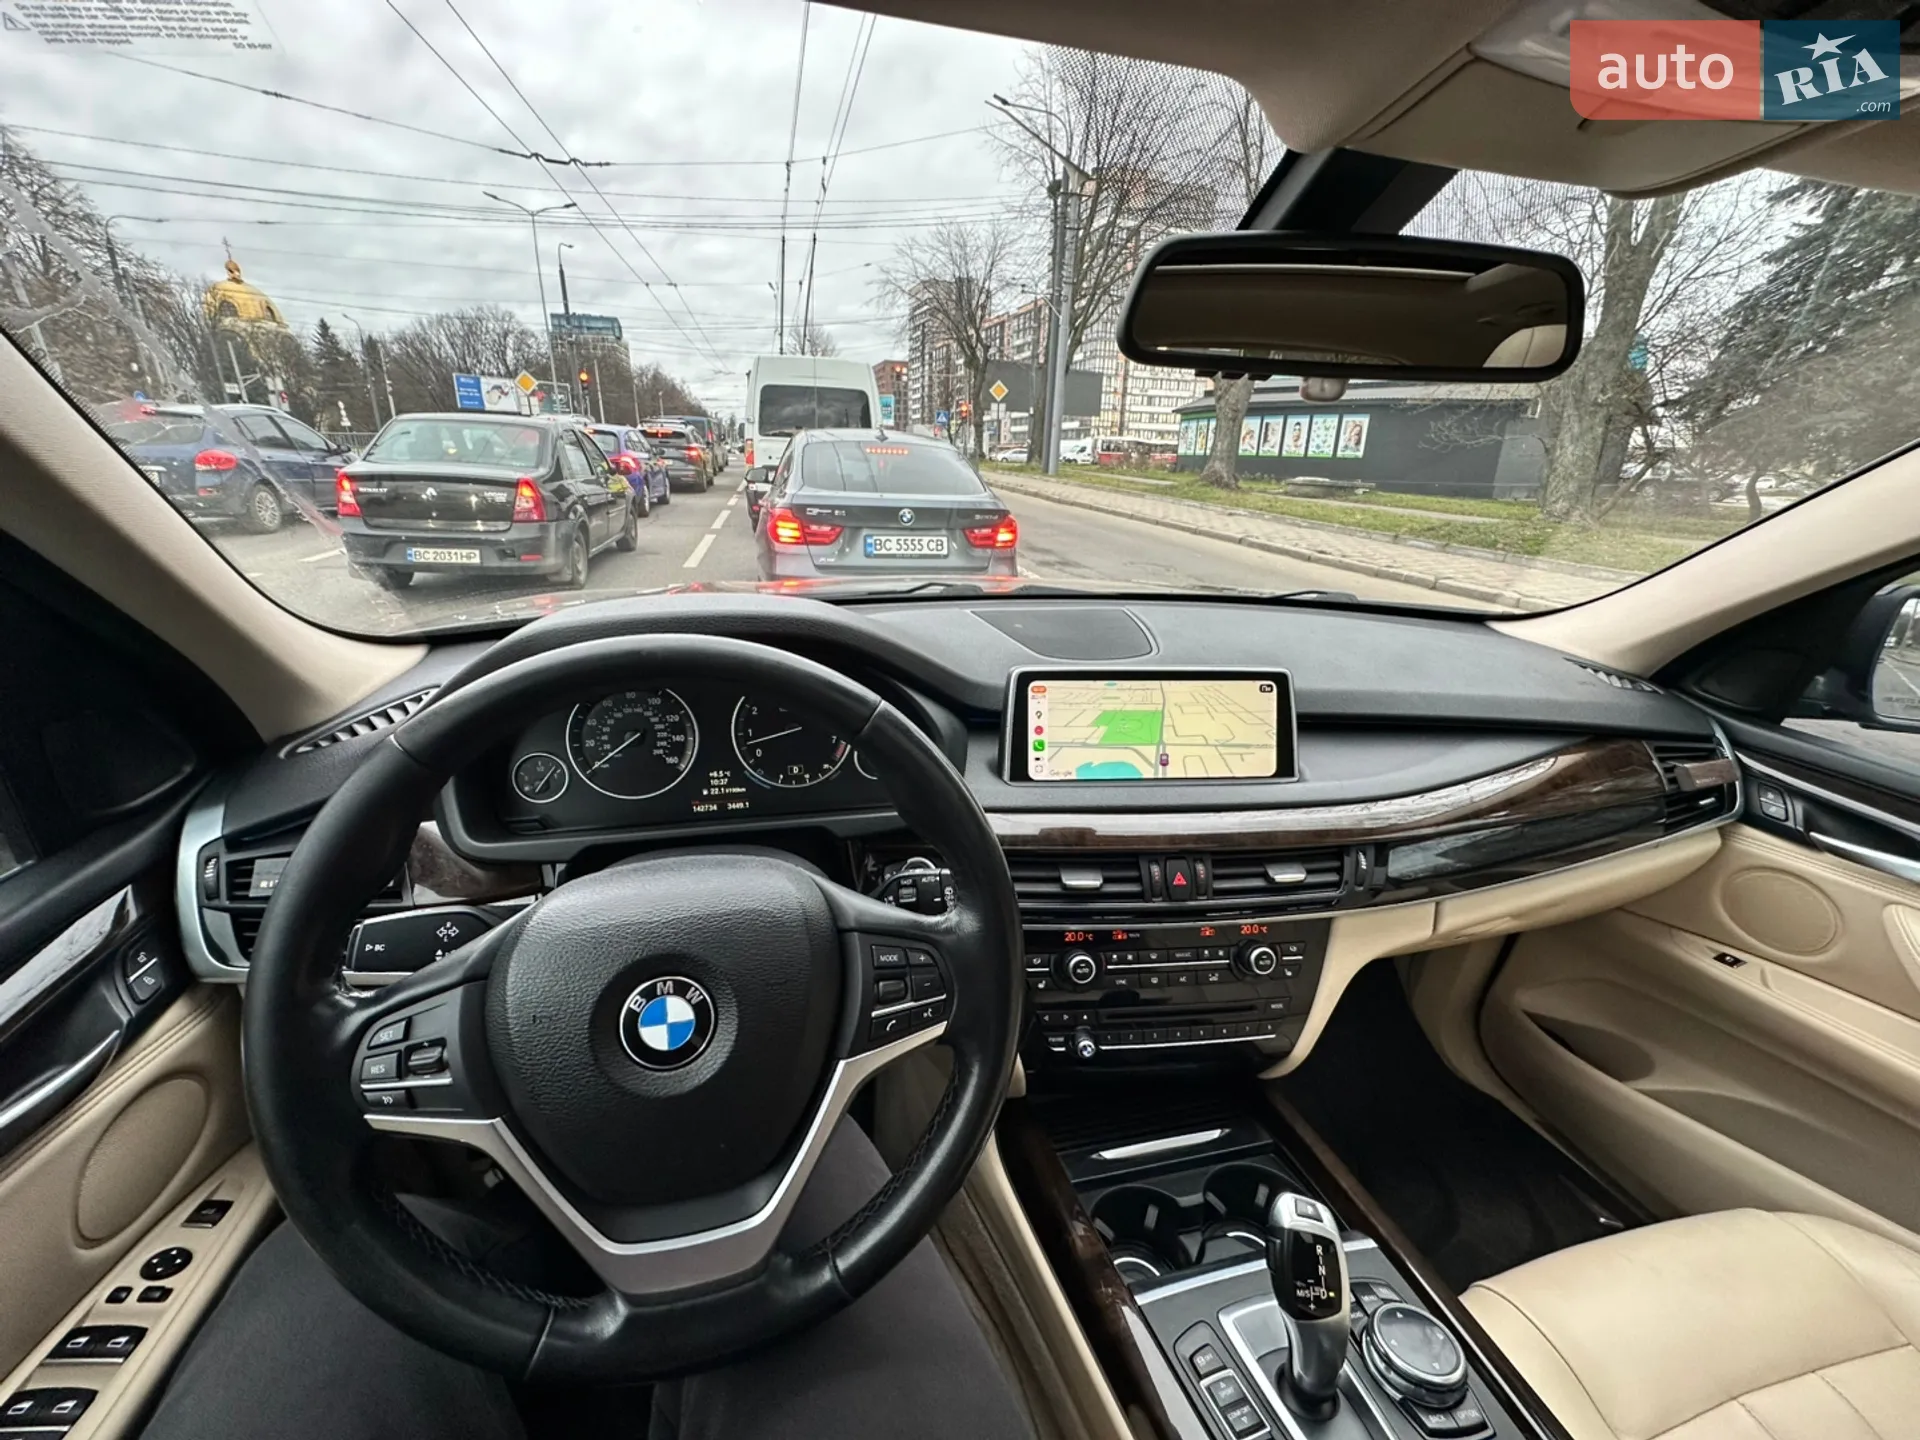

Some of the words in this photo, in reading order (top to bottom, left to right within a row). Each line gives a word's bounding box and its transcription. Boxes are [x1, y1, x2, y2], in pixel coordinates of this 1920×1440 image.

[874, 538, 893, 552] BC
[895, 537, 924, 552] 5555
[926, 539, 945, 552] CB
[413, 549, 431, 560] BC
[433, 549, 460, 562] 2031
[460, 552, 477, 562] HP
[646, 697, 661, 706] 100
[752, 707, 758, 715] 2
[665, 714, 680, 722] 120
[748, 729, 753, 737] 1
[671, 734, 686, 743] 140
[831, 735, 837, 744] 7
[585, 739, 596, 748] 20
[755, 748, 762, 757] 0
[665, 756, 679, 764] 160
[374, 943, 386, 952] BC
[879, 954, 899, 962] MODE
[629, 980, 704, 1013] BMW
[380, 1030, 394, 1041] SET
[370, 1064, 385, 1075] RES
[1315, 1244, 1323, 1256] R
[1318, 1265, 1326, 1276] N
[1296, 1288, 1310, 1298] M/S
[1320, 1288, 1328, 1300] D
[1361, 1294, 1378, 1302] MENU
[1428, 1413, 1446, 1424] BACK
